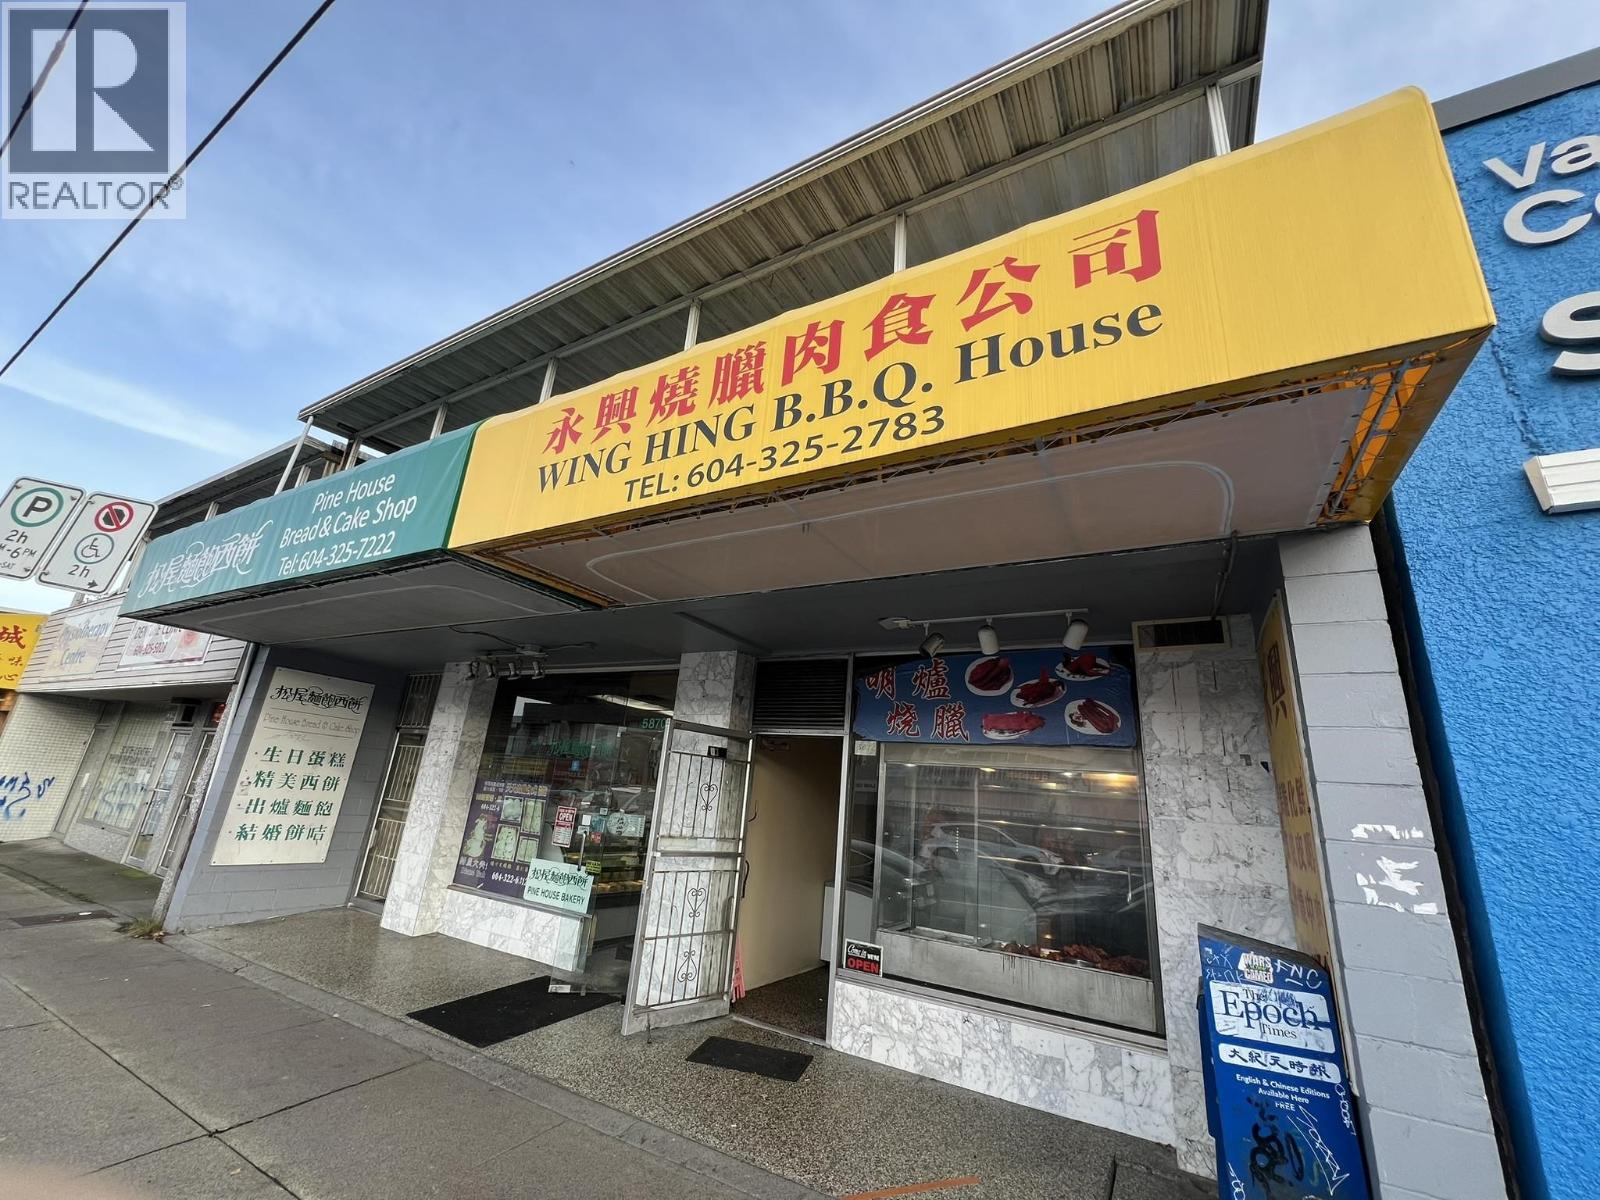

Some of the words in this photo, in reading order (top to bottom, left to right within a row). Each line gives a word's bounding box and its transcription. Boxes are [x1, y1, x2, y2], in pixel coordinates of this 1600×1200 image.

[538, 440, 632, 494] WING
[641, 403, 757, 466] HING
[769, 361, 933, 433] B.B.Q.
[954, 303, 1163, 385] House
[624, 472, 680, 502] TEL:
[686, 405, 945, 488] 604-325-2783
[312, 490, 344, 514] Pine
[345, 473, 396, 504] House
[372, 495, 418, 524] Shop
[5, 529, 28, 544] 2h
[67, 564, 90, 578] 2h
[260, 745, 347, 768] 生日蛋糕
[252, 770, 341, 793] 精美西餅
[558, 812, 573, 822] OPEN
[527, 886, 541, 895] PINE
[541, 888, 561, 900] HOUSE
[561, 892, 586, 905] BAKERY
[847, 957, 879, 974] OPEN
[1219, 989, 1323, 1031] Epoch
[1260, 1023, 1298, 1040] Times
[1235, 1073, 1261, 1085] English
[1262, 1079, 1270, 1087] &
[1270, 1081, 1299, 1093] Chinese
[1300, 1086, 1331, 1099] Editions
[1258, 1087, 1290, 1100] Available
[1290, 1094, 1310, 1104] Here
[1275, 1102, 1296, 1112] FREE
